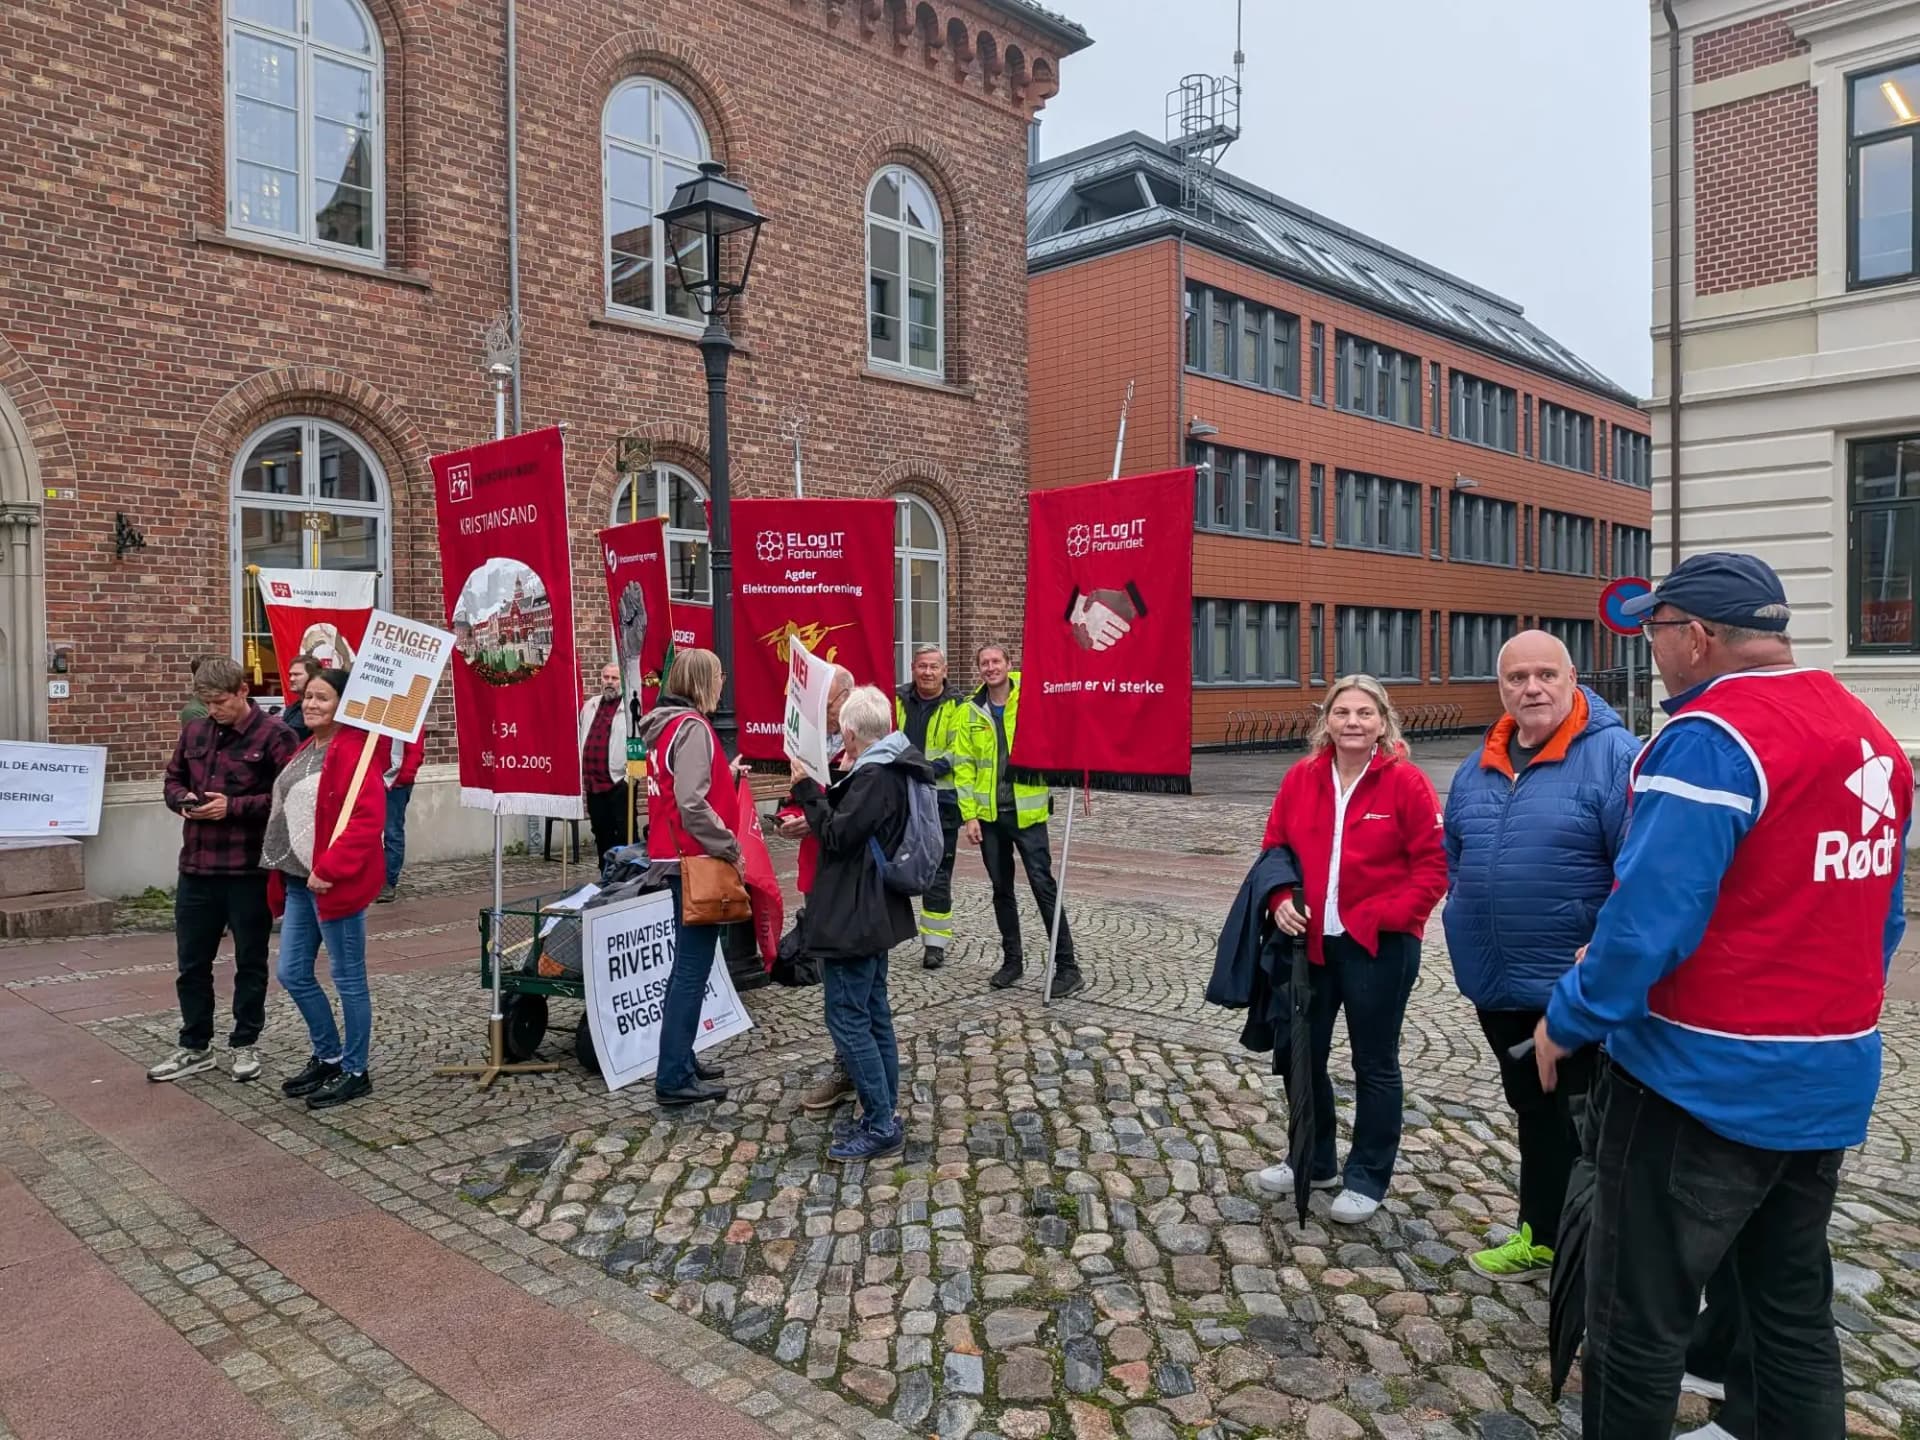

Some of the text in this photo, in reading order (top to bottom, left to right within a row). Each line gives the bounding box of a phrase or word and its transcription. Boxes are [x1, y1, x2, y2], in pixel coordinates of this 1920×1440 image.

[1092, 538, 1144, 552] Forbundet
[787, 549, 843, 559] Forbundet
[785, 569, 817, 582] Agder
[742, 583, 863, 597] Elektromontørforening
[373, 621, 442, 654] PENGER
[371, 637, 438, 663] TIL DE ANSATTE
[373, 653, 391, 664] IKKE
[392, 658, 403, 668] TIL
[363, 662, 395, 676] PRIVATE
[360, 673, 395, 688] AKTØRER
[1043, 679, 1164, 694] Sammen er vi sterke
[53, 684, 66, 694] 28
[787, 705, 800, 739] JA
[500, 722, 517, 738] 34
[12, 761, 29, 771] DE
[1813, 825, 1897, 882] Rødt
[608, 943, 664, 983] RIVER
